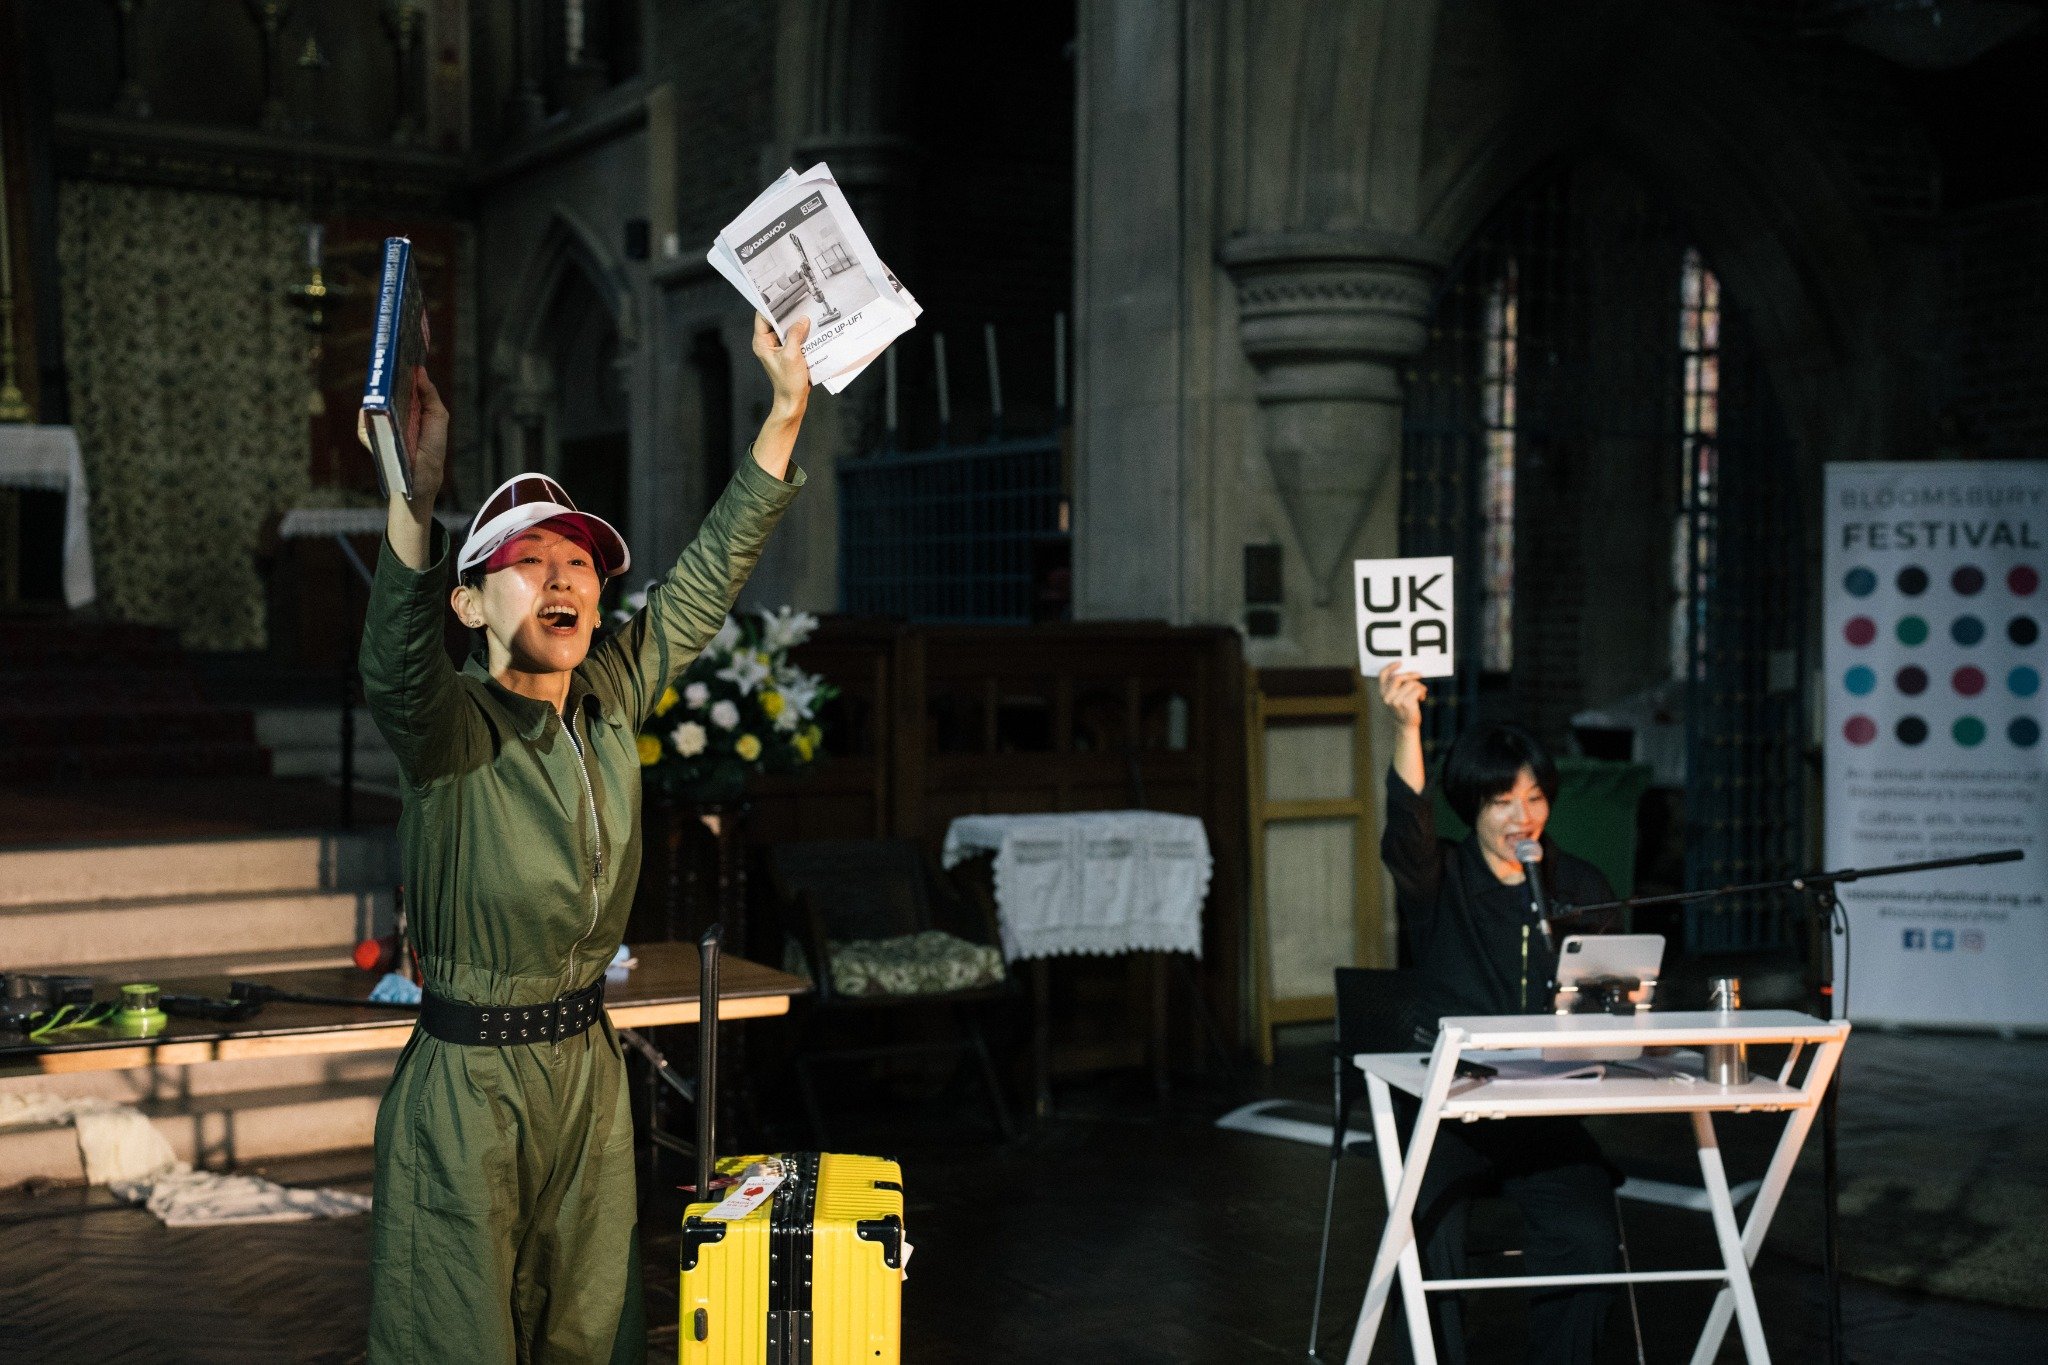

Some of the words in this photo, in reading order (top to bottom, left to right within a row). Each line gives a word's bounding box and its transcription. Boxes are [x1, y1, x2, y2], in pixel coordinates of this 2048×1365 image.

[752, 221, 787, 250] DAEWOO
[800, 330, 833, 355] ORNADO
[834, 312, 863, 334] UP-LIFT
[1842, 520, 2041, 551] FESTIVAL
[1363, 573, 1445, 613] UK
[1365, 619, 1447, 657] CA
